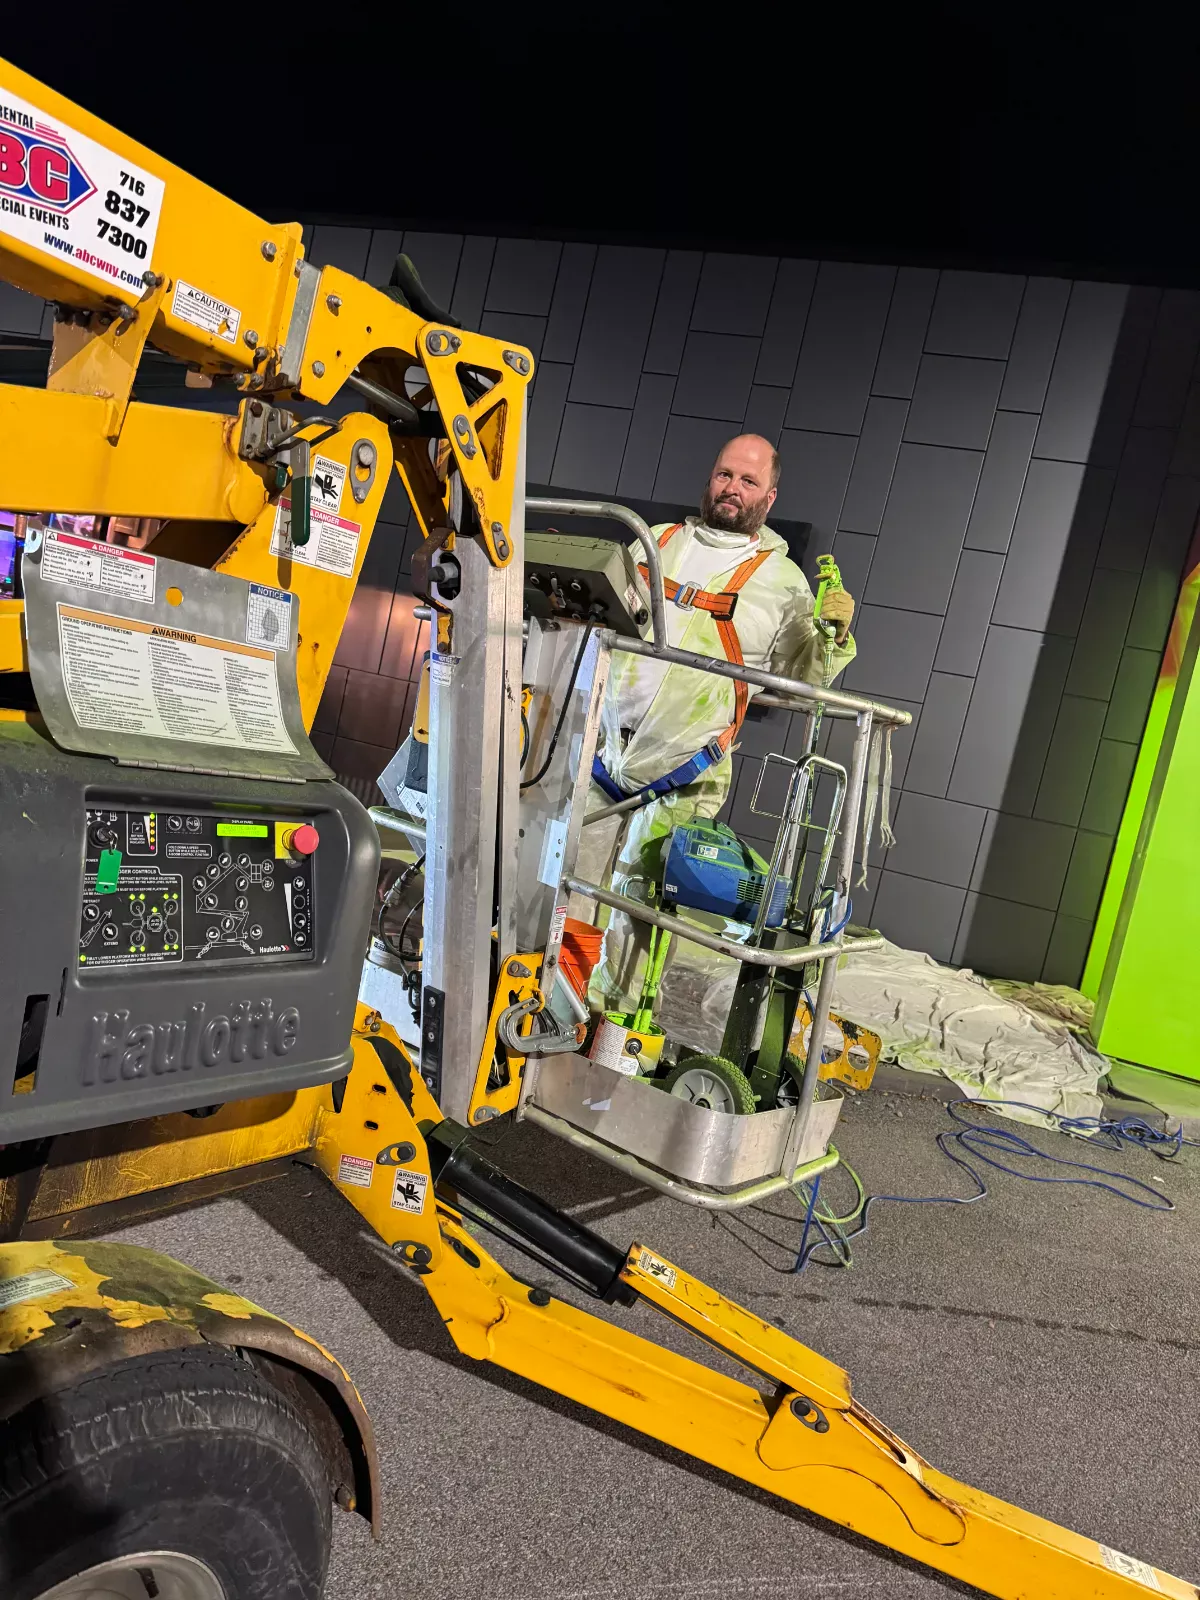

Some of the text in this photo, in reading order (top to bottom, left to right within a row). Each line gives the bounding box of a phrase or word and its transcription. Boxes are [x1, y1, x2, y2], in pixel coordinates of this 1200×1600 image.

[120, 171, 145, 197] 716
[0, 196, 69, 230] CIAL EVENTS
[104, 190, 150, 229] 837
[97, 218, 148, 260] 7300
[43, 232, 144, 289] www.abcwny.com
[194, 292, 231, 316] CAUTION
[315, 512, 340, 525] DANGER
[98, 545, 124, 557] DANGER
[257, 587, 284, 600] NOTICE
[158, 628, 197, 643] WARNING
[259, 945, 282, 953] Haulotte
[82, 998, 299, 1086] Haulotte
[347, 1157, 373, 1168] DANGER
